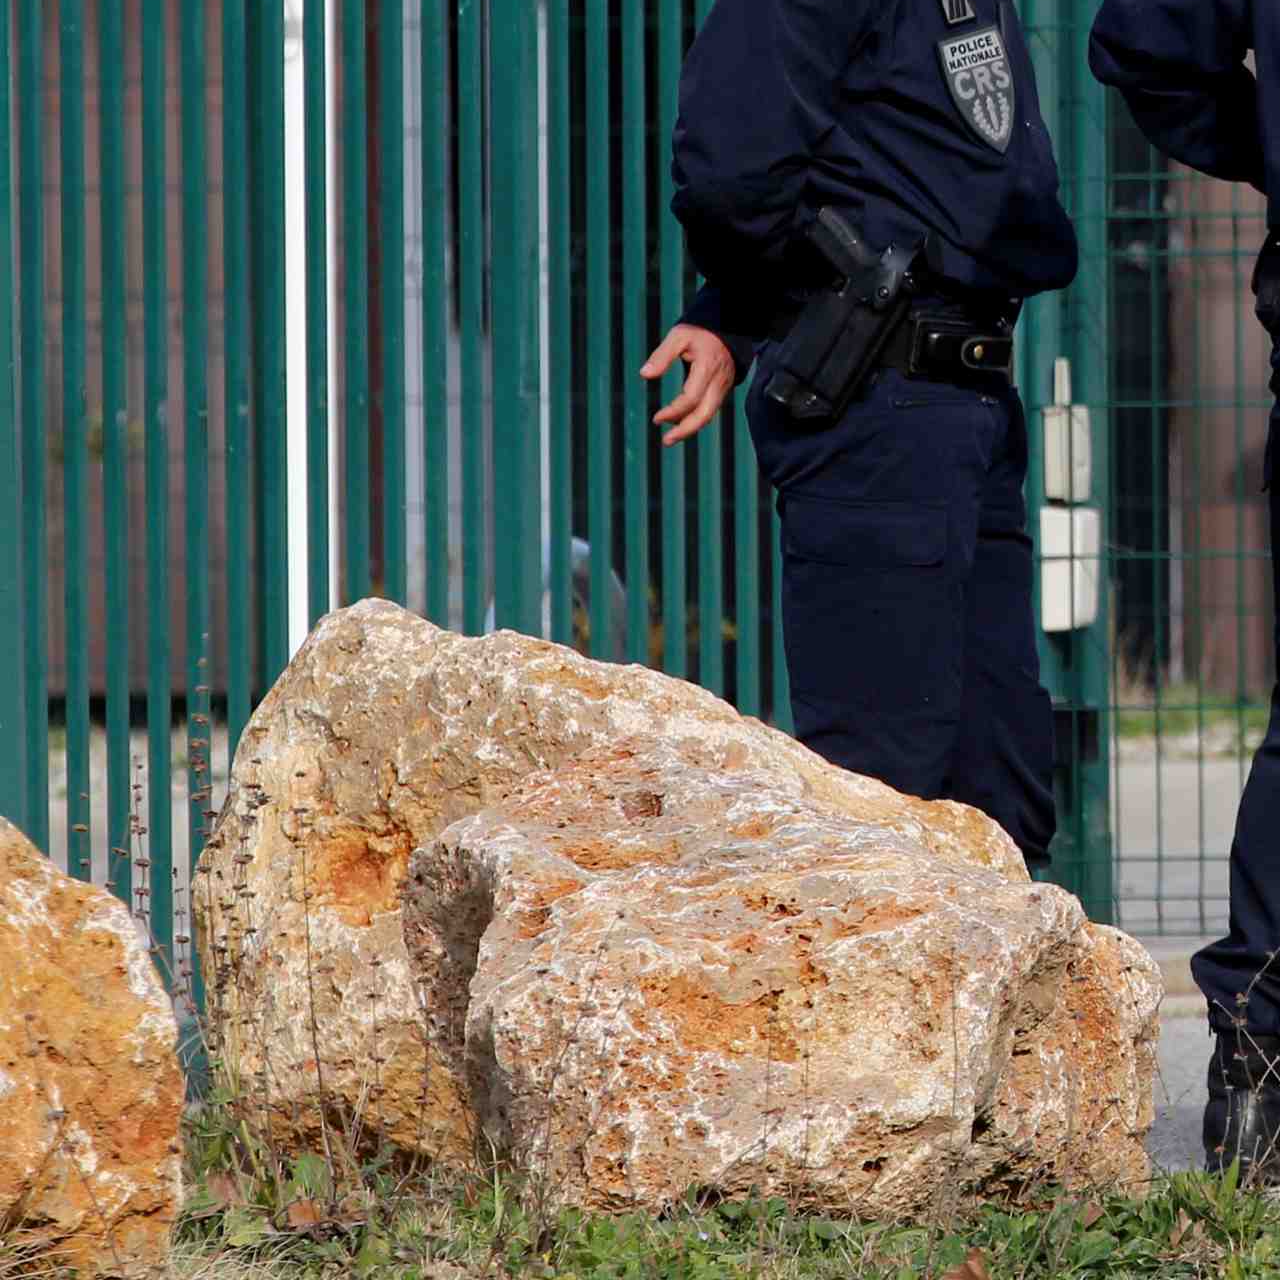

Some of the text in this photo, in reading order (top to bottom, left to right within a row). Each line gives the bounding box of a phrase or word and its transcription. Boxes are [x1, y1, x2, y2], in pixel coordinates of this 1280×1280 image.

[948, 46, 1002, 70] NATIONALE
[950, 35, 993, 57] POLICE
[954, 61, 1010, 100] CRS
